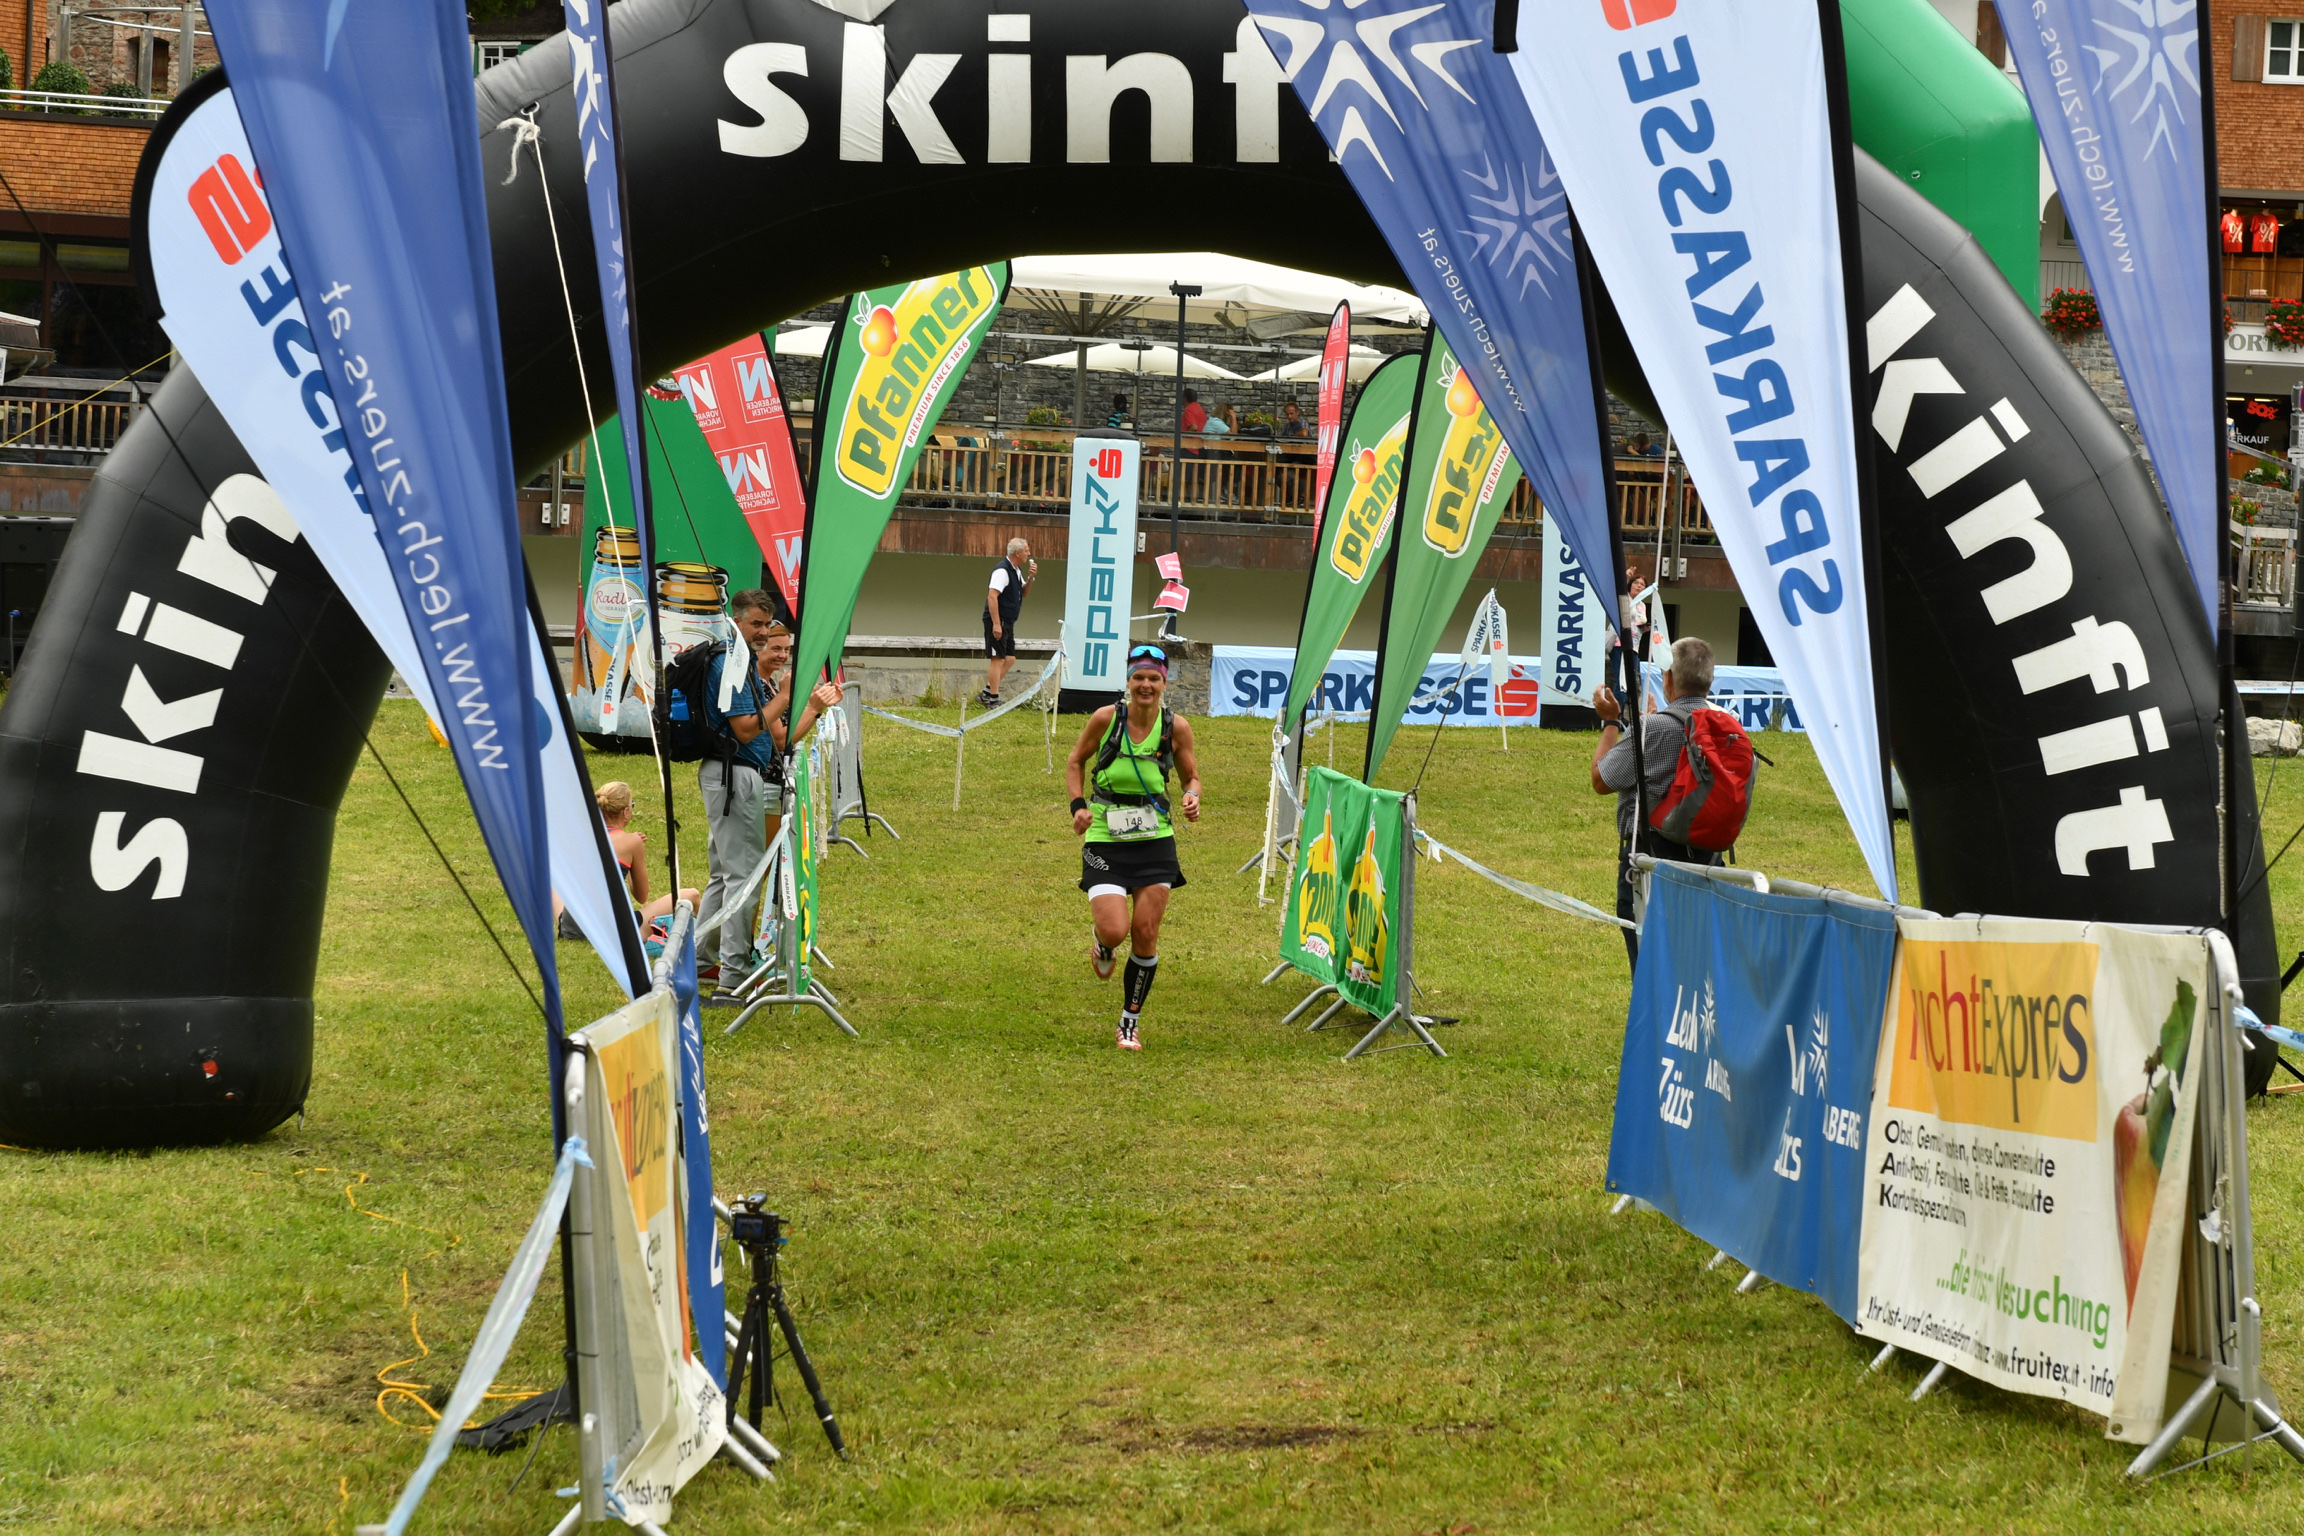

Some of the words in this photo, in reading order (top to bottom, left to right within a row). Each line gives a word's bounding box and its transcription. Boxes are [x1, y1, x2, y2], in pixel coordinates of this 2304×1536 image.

[849, 268, 980, 476] Pfanner
[907, 392, 934, 444] PREMIUM
[930, 363, 952, 392] SINCE
[950, 340, 969, 364] 1856
[1482, 445, 1510, 500] PREMIUM
[1555, 527, 1586, 695] SPARKAS
[1865, 283, 2174, 877] kinfit
[1124, 816, 1144, 828] 148
